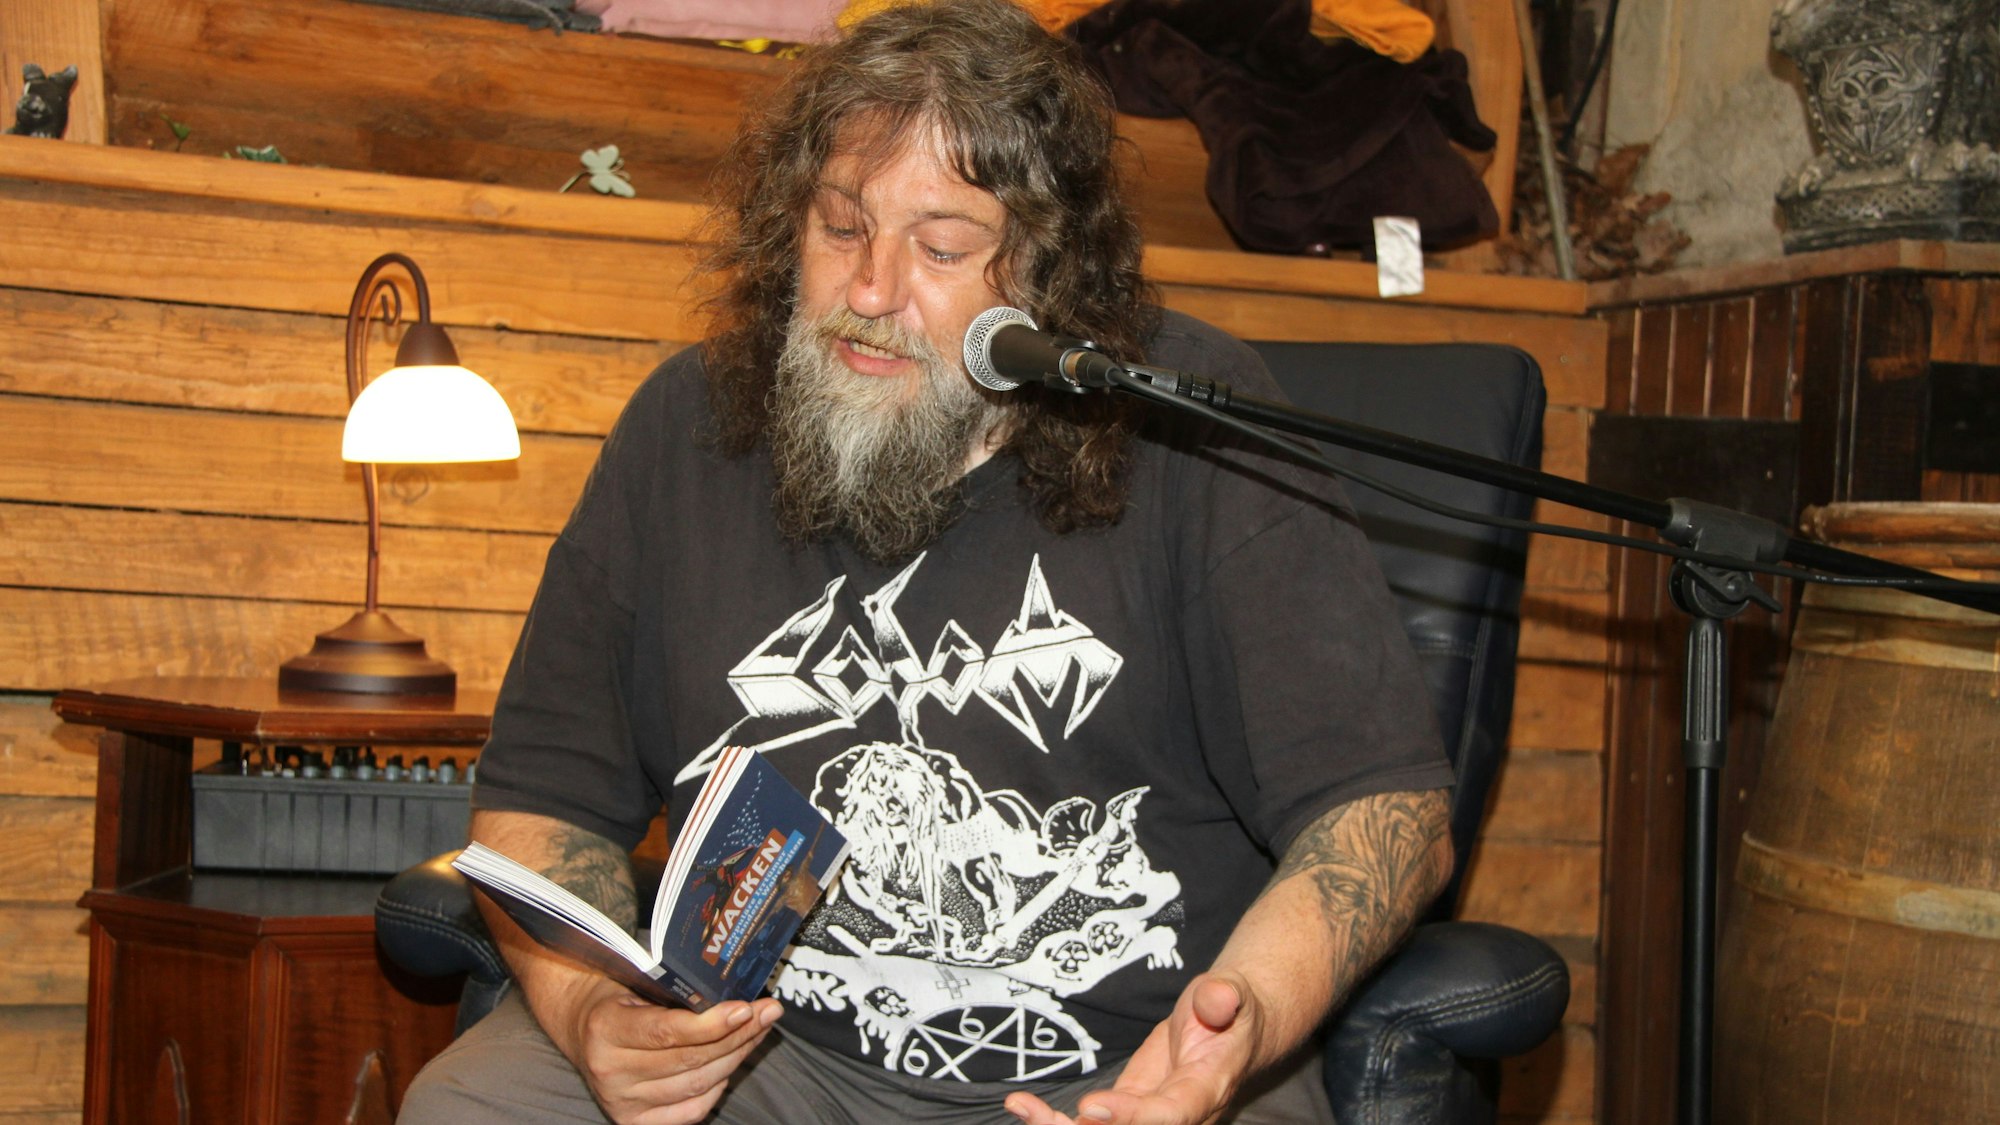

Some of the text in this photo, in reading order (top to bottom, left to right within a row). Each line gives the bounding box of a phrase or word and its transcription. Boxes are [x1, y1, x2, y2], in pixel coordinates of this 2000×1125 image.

[706, 837, 782, 954] WACKEN
[726, 837, 804, 957] und andere Wahrheiten
[726, 850, 786, 945] Populäre Irrtümer
[903, 1007, 1058, 1076] 6 6 6
